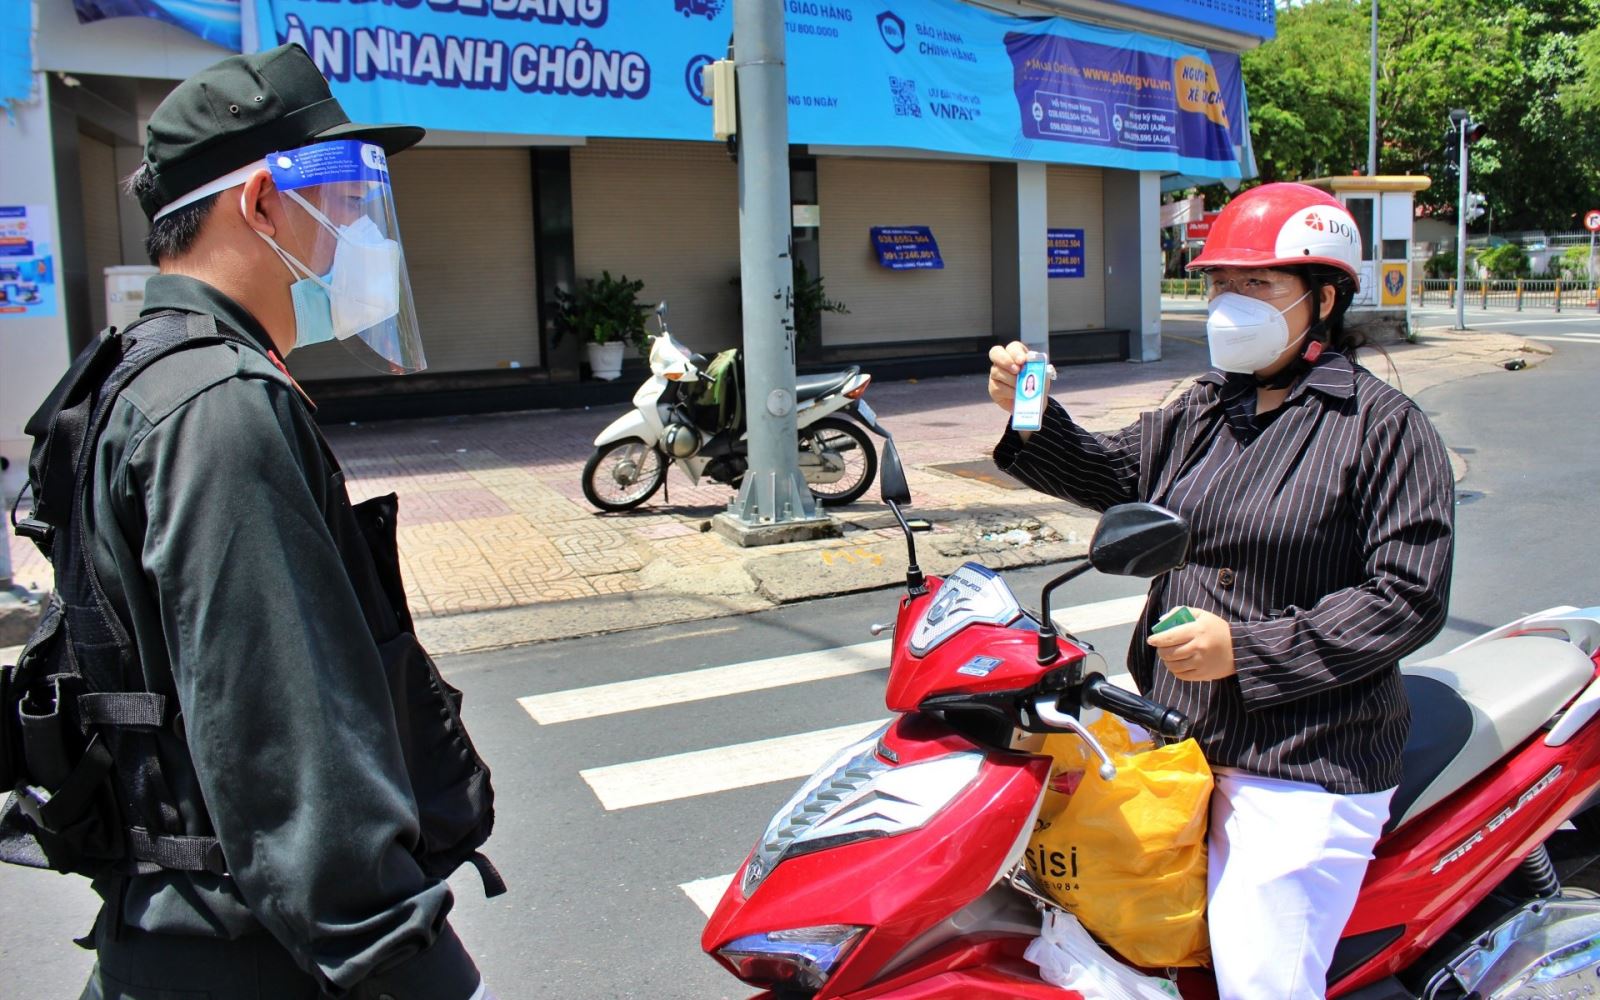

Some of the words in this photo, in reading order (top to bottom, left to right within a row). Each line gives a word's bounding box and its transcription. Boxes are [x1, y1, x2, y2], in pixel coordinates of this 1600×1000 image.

[789, 0, 818, 16] GIAO
[355, 26, 503, 84] NHANH
[511, 39, 646, 93] CHÓNG
